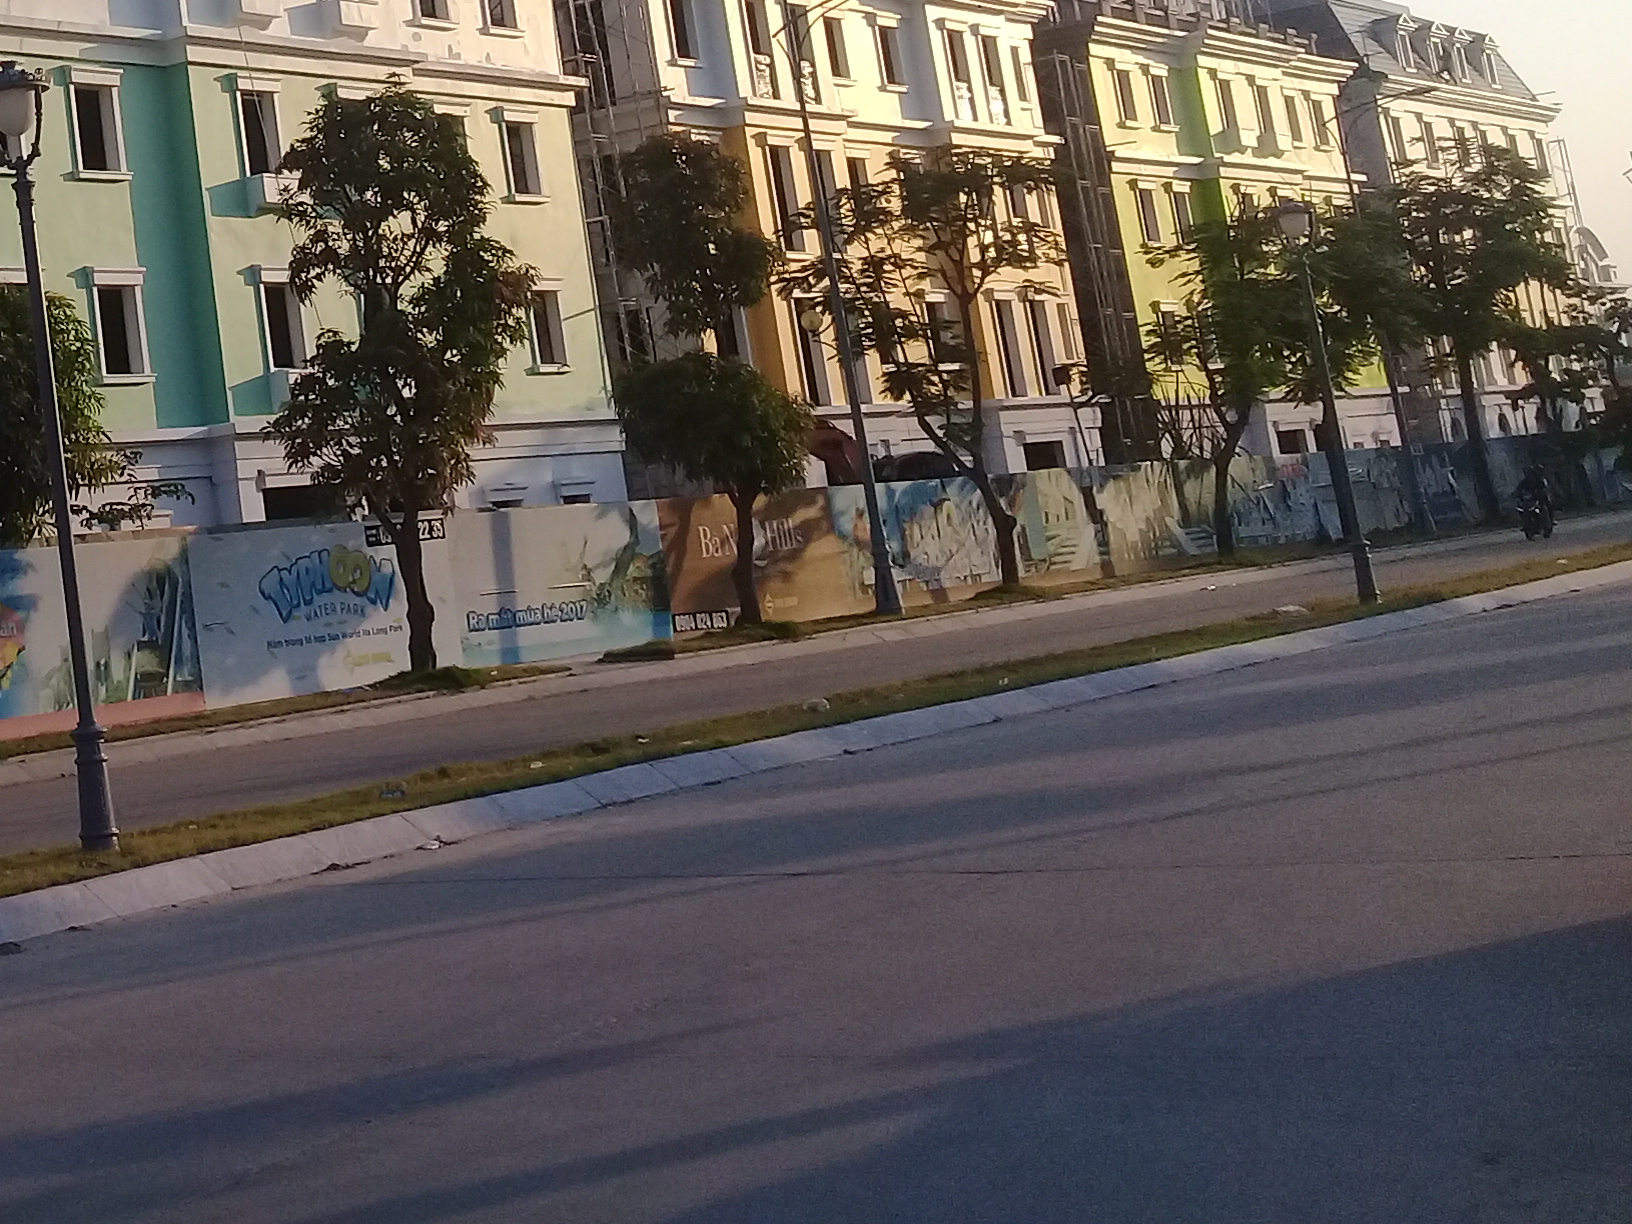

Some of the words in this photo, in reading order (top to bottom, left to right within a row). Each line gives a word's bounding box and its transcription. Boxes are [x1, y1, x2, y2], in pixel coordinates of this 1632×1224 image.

[722, 523, 738, 555] N
[765, 518, 804, 551] Hills
[259, 544, 395, 624] TYPHOON
[304, 602, 336, 622] WATER
[339, 601, 367, 618] PARK
[467, 611, 486, 632] Ra
[559, 599, 587, 622] 2017
